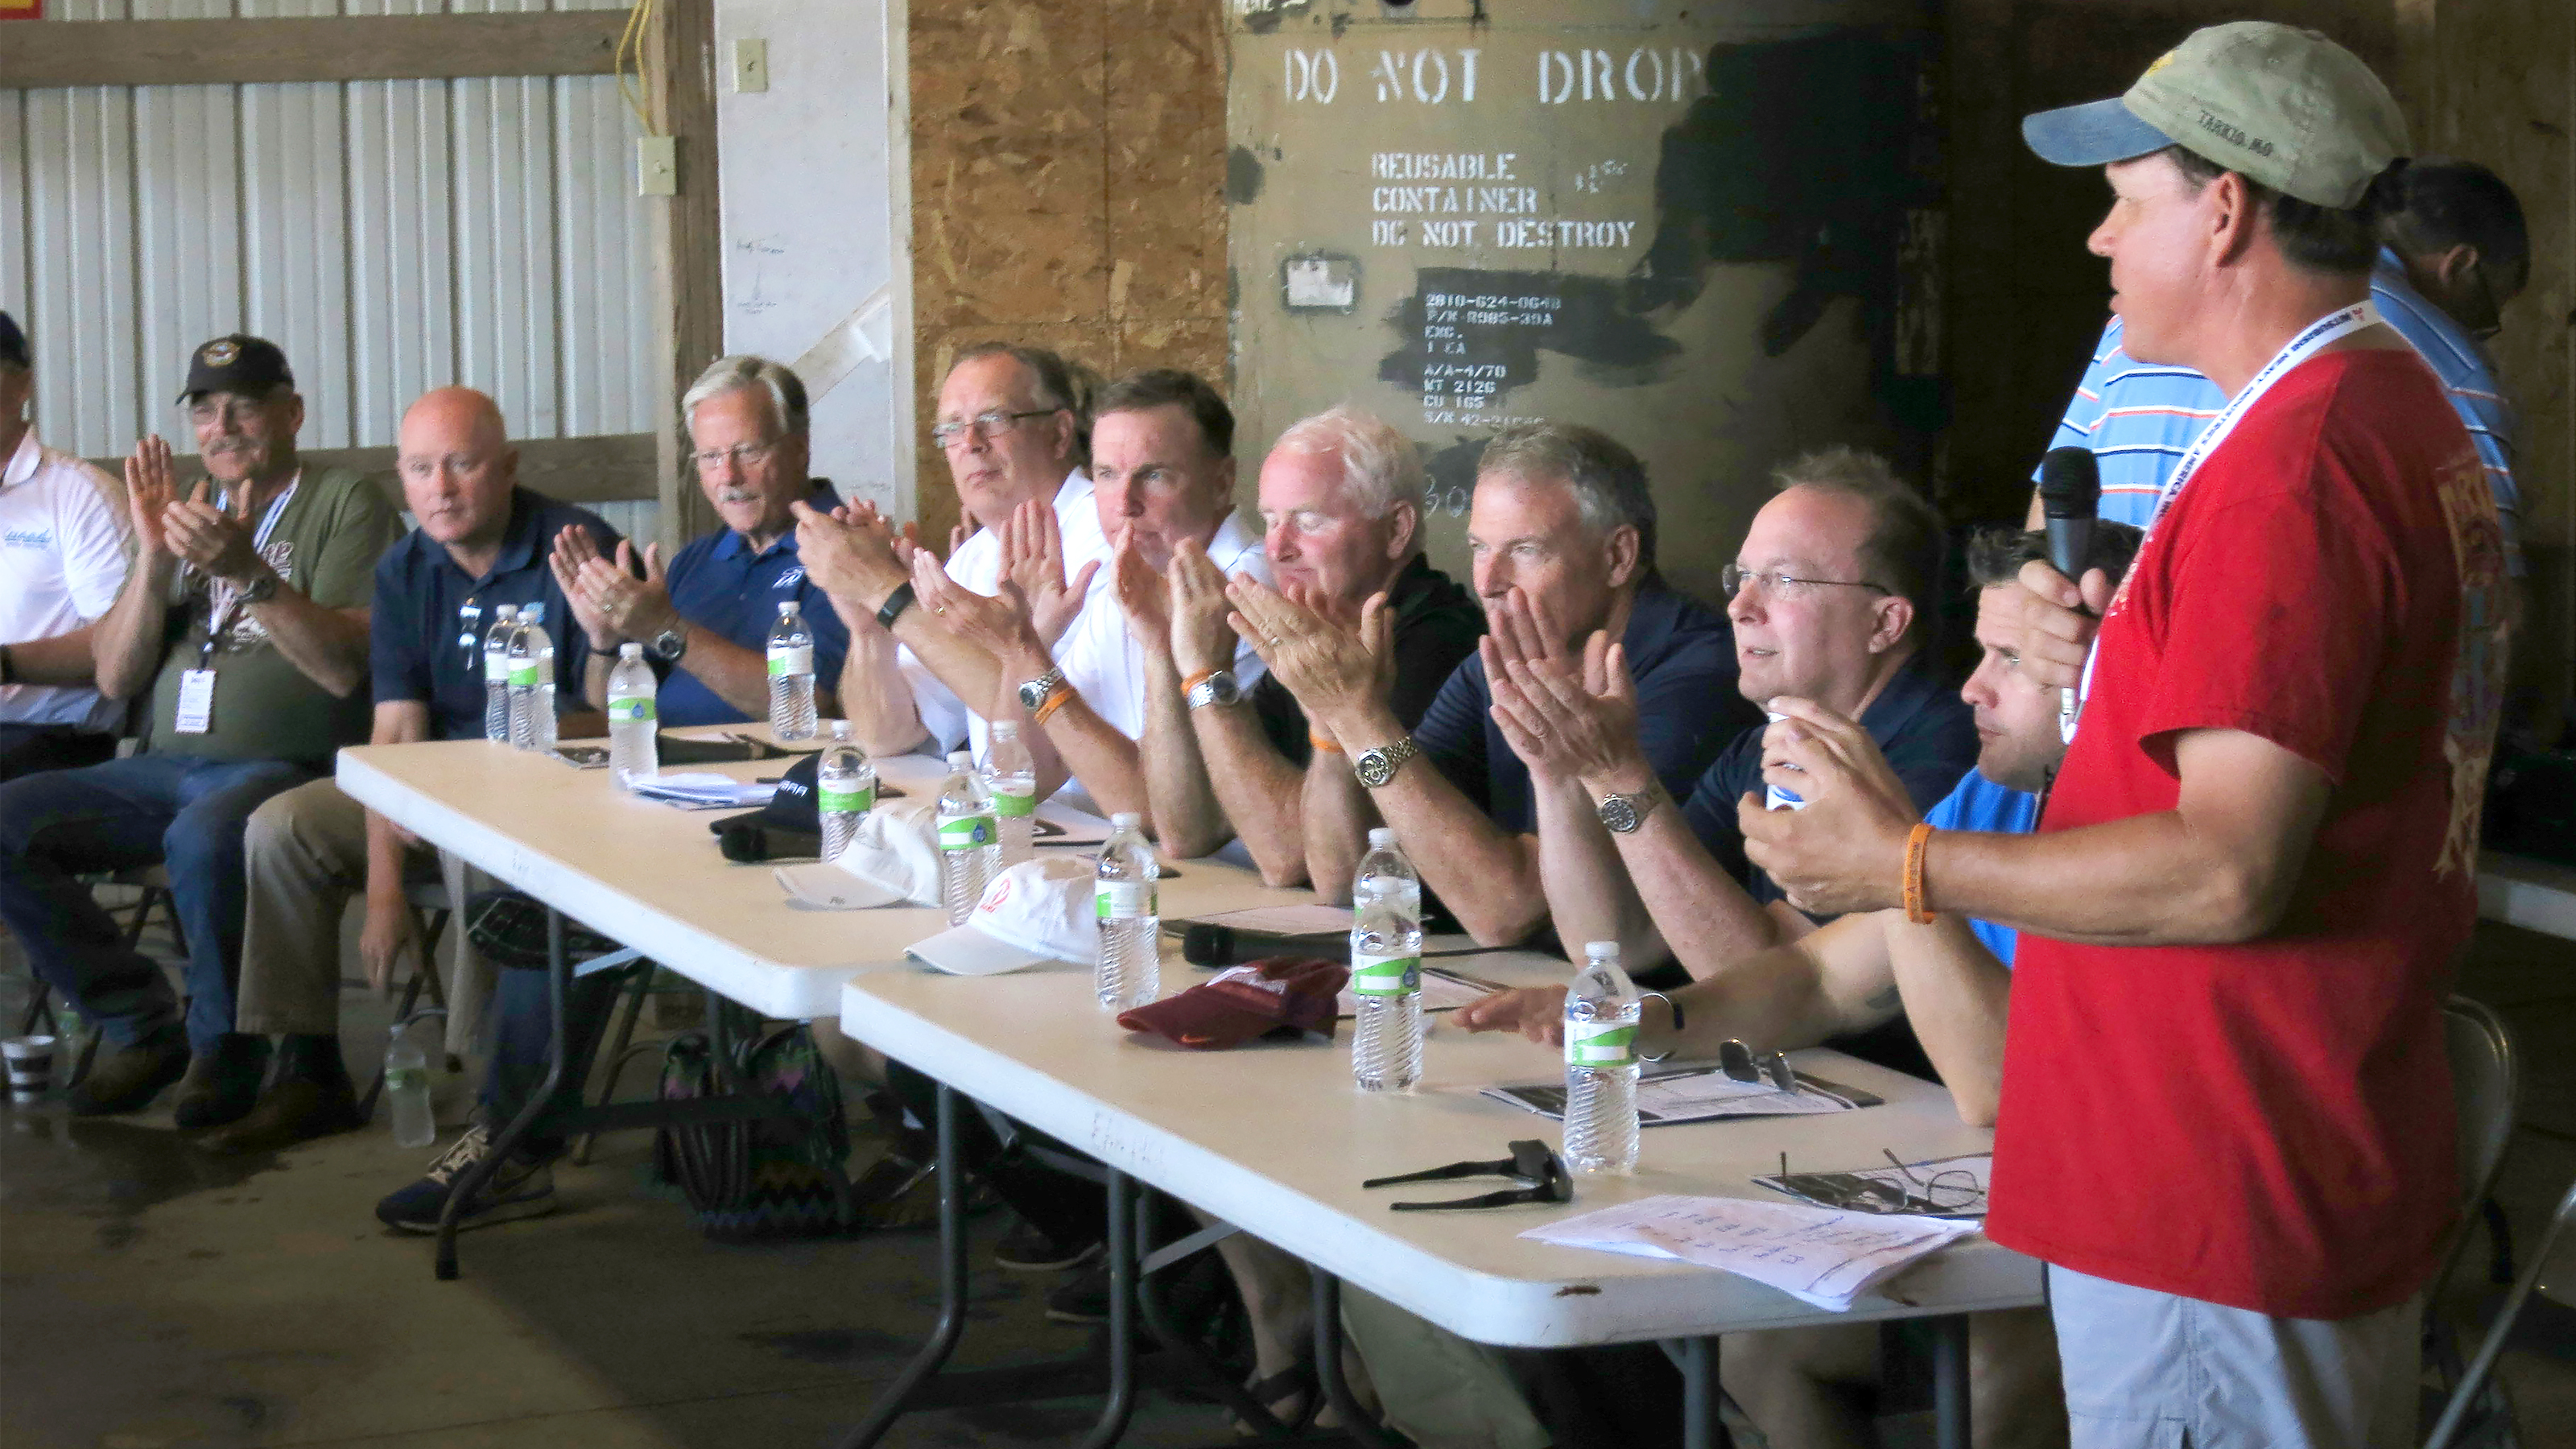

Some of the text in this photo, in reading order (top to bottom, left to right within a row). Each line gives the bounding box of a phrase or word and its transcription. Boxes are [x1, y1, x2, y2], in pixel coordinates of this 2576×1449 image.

[1285, 47, 1701, 104] DO NOT DROP
[1371, 153, 1516, 180] REUSABLE
[1373, 187, 1538, 213] CONTAINER
[1422, 221, 1479, 247] NOT
[1496, 218, 1636, 248] DESTROY
[1454, 379, 1496, 394] 2126
[1423, 394, 1485, 410] CU 165
